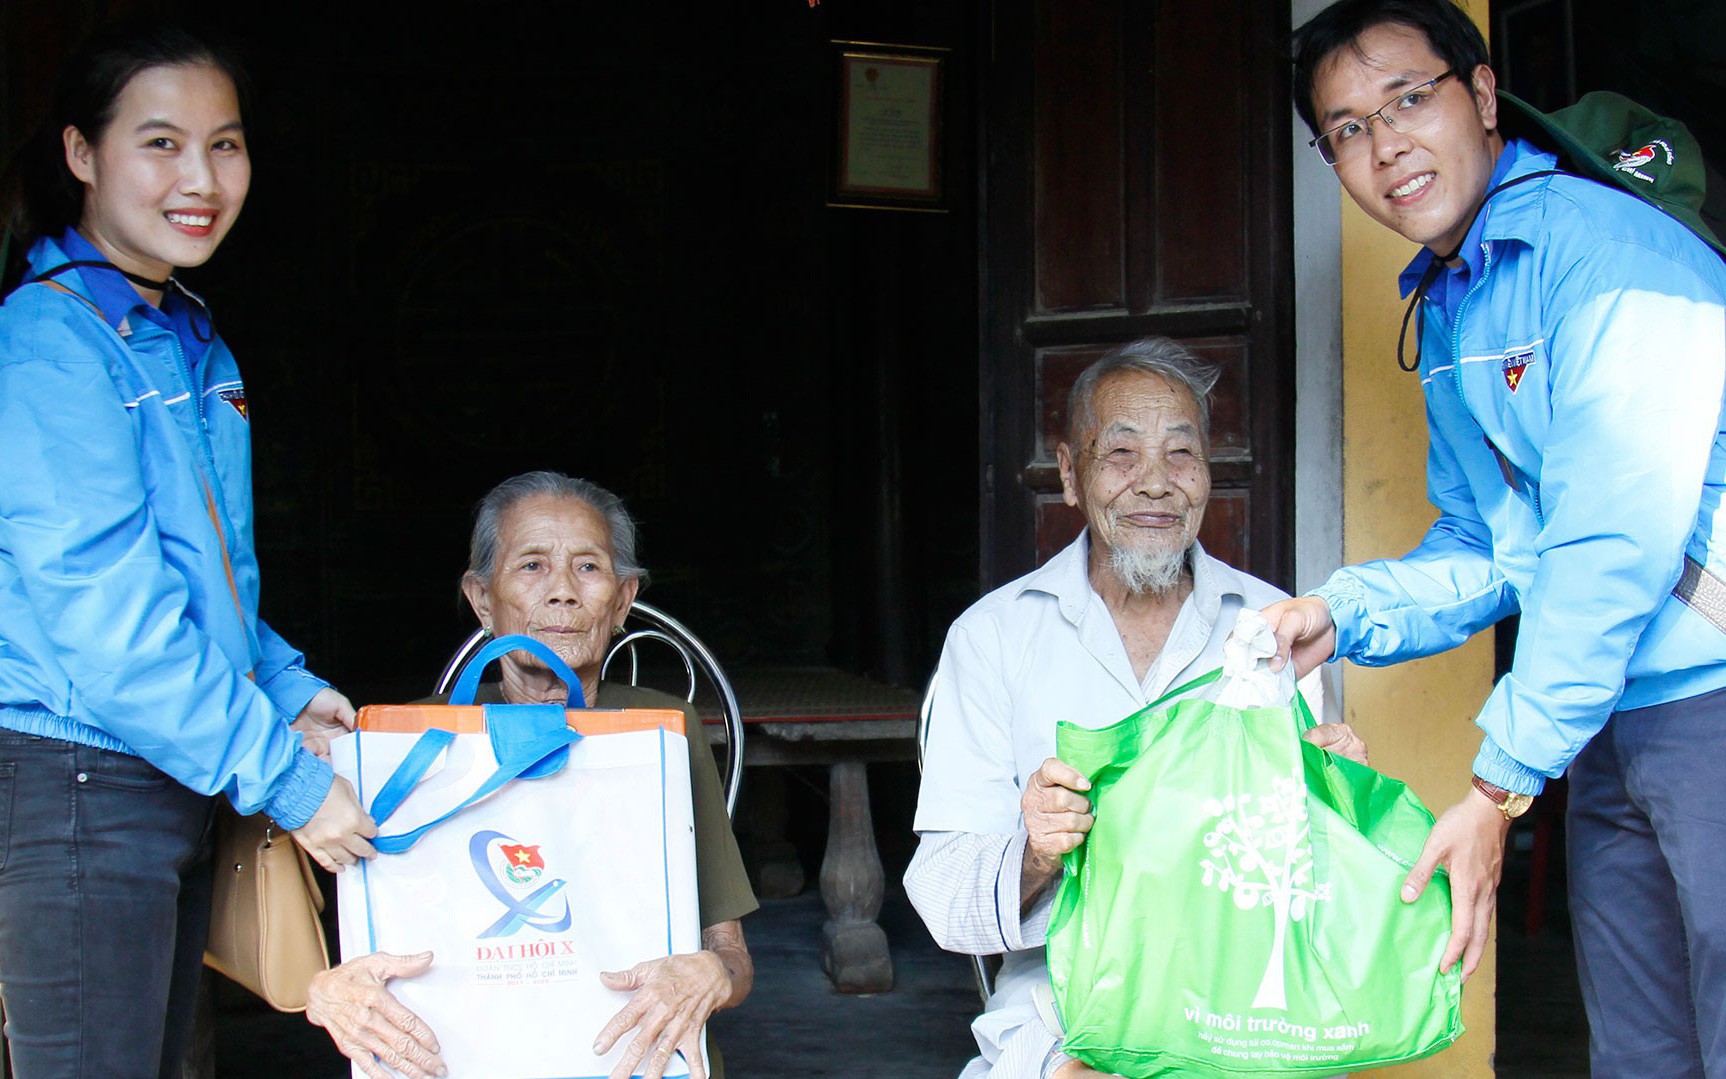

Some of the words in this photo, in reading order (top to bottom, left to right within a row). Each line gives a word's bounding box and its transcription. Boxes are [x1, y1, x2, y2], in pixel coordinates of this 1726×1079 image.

[560, 940, 575, 955] X
[1206, 1012, 1241, 1032] môi
[1247, 1015, 1317, 1042] trường
[1323, 1021, 1370, 1040] xanh
